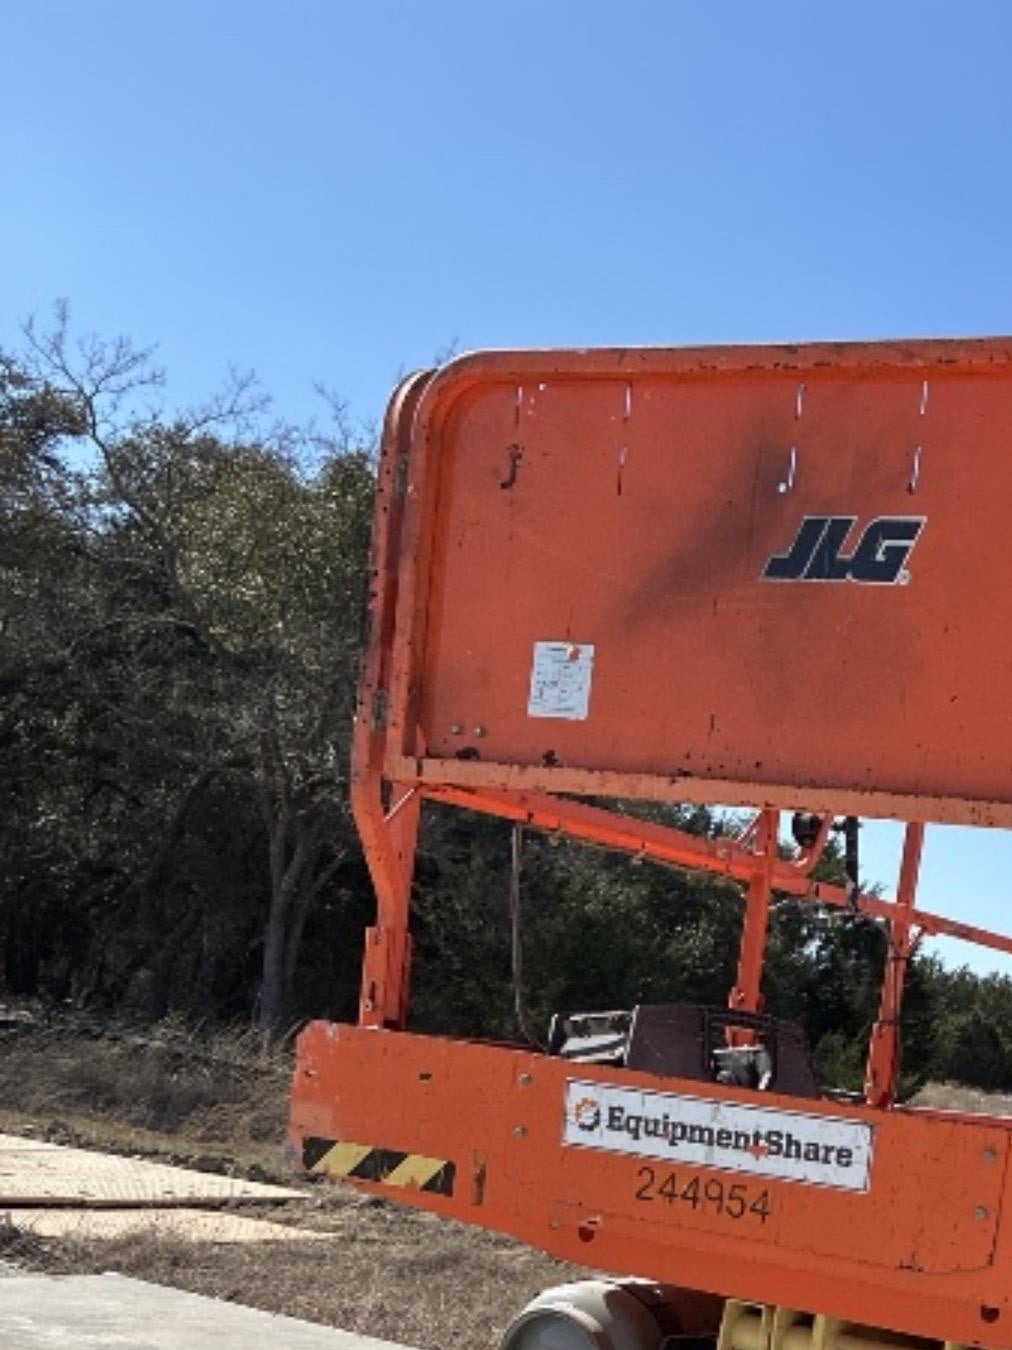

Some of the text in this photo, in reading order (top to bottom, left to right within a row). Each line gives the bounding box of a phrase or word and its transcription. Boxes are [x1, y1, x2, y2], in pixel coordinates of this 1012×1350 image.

[760, 515, 928, 585] JLG
[607, 1106, 853, 1167] EquipmentShare
[635, 1166, 770, 1224] 244954
